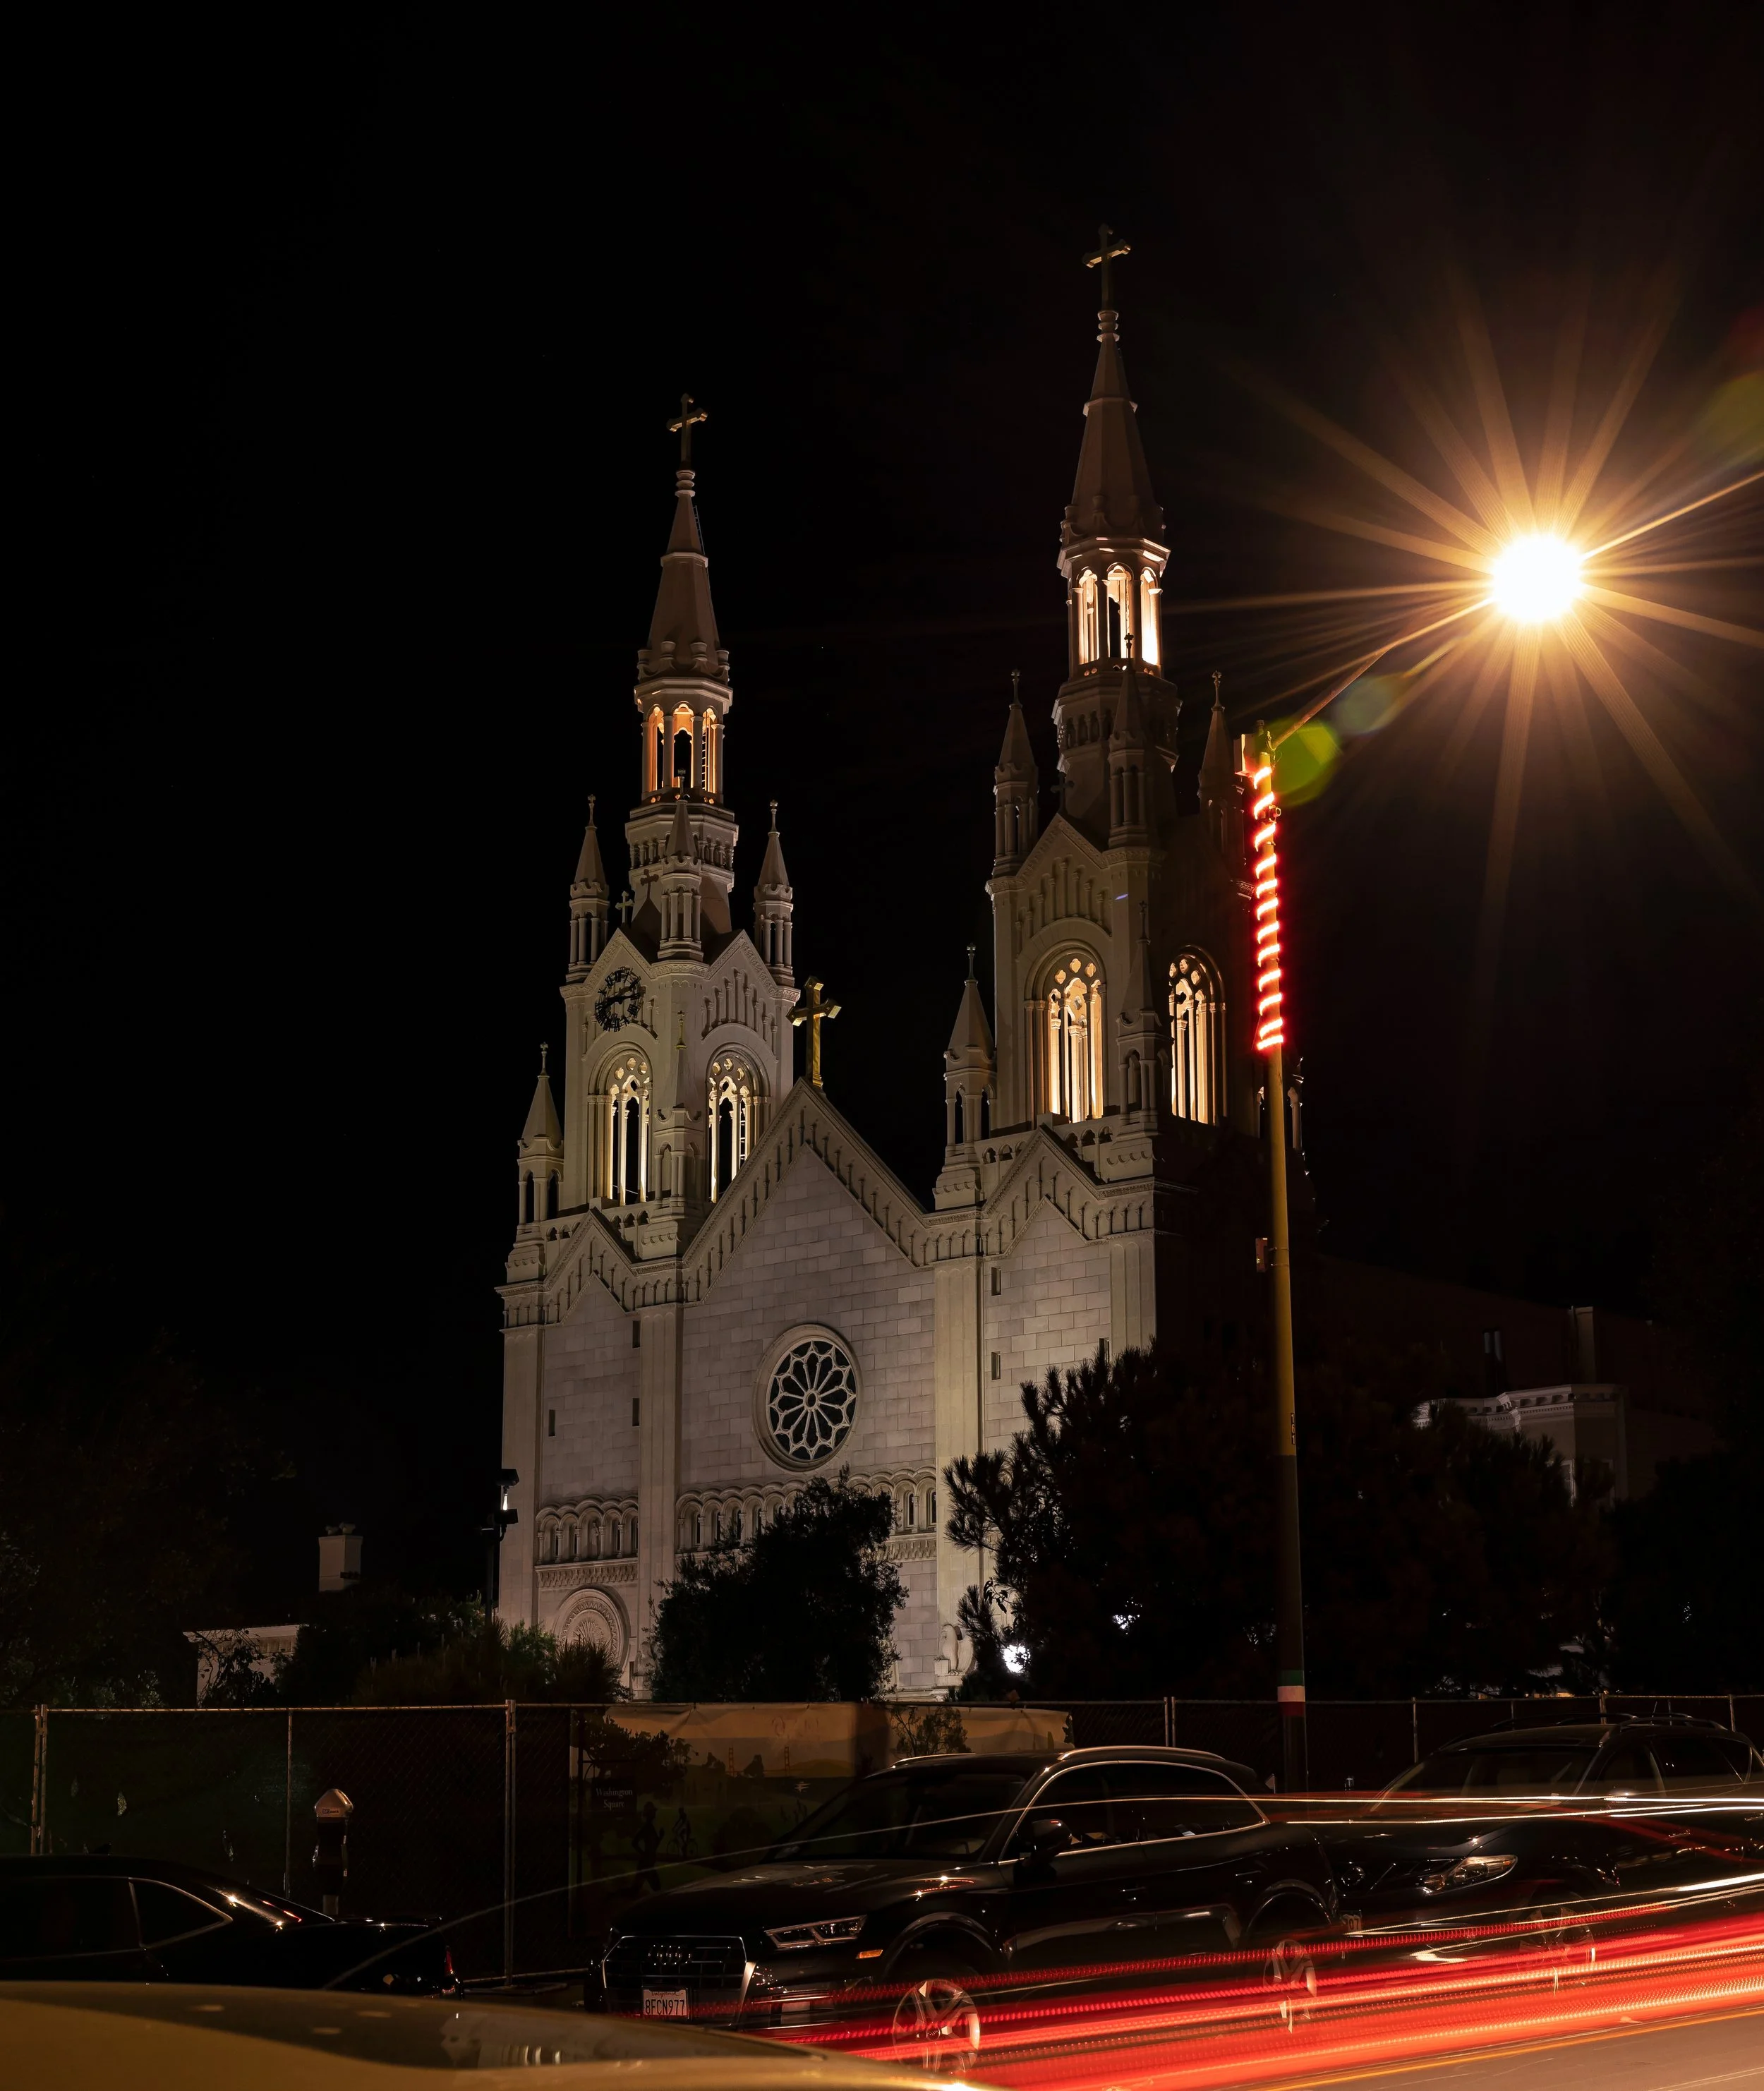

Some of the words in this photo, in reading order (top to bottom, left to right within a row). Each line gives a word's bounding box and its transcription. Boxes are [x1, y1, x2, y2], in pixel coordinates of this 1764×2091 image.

[596, 1786, 634, 1799] Washington
[603, 1799, 626, 1811] Square
[645, 1999, 684, 2015] 8FCN977
